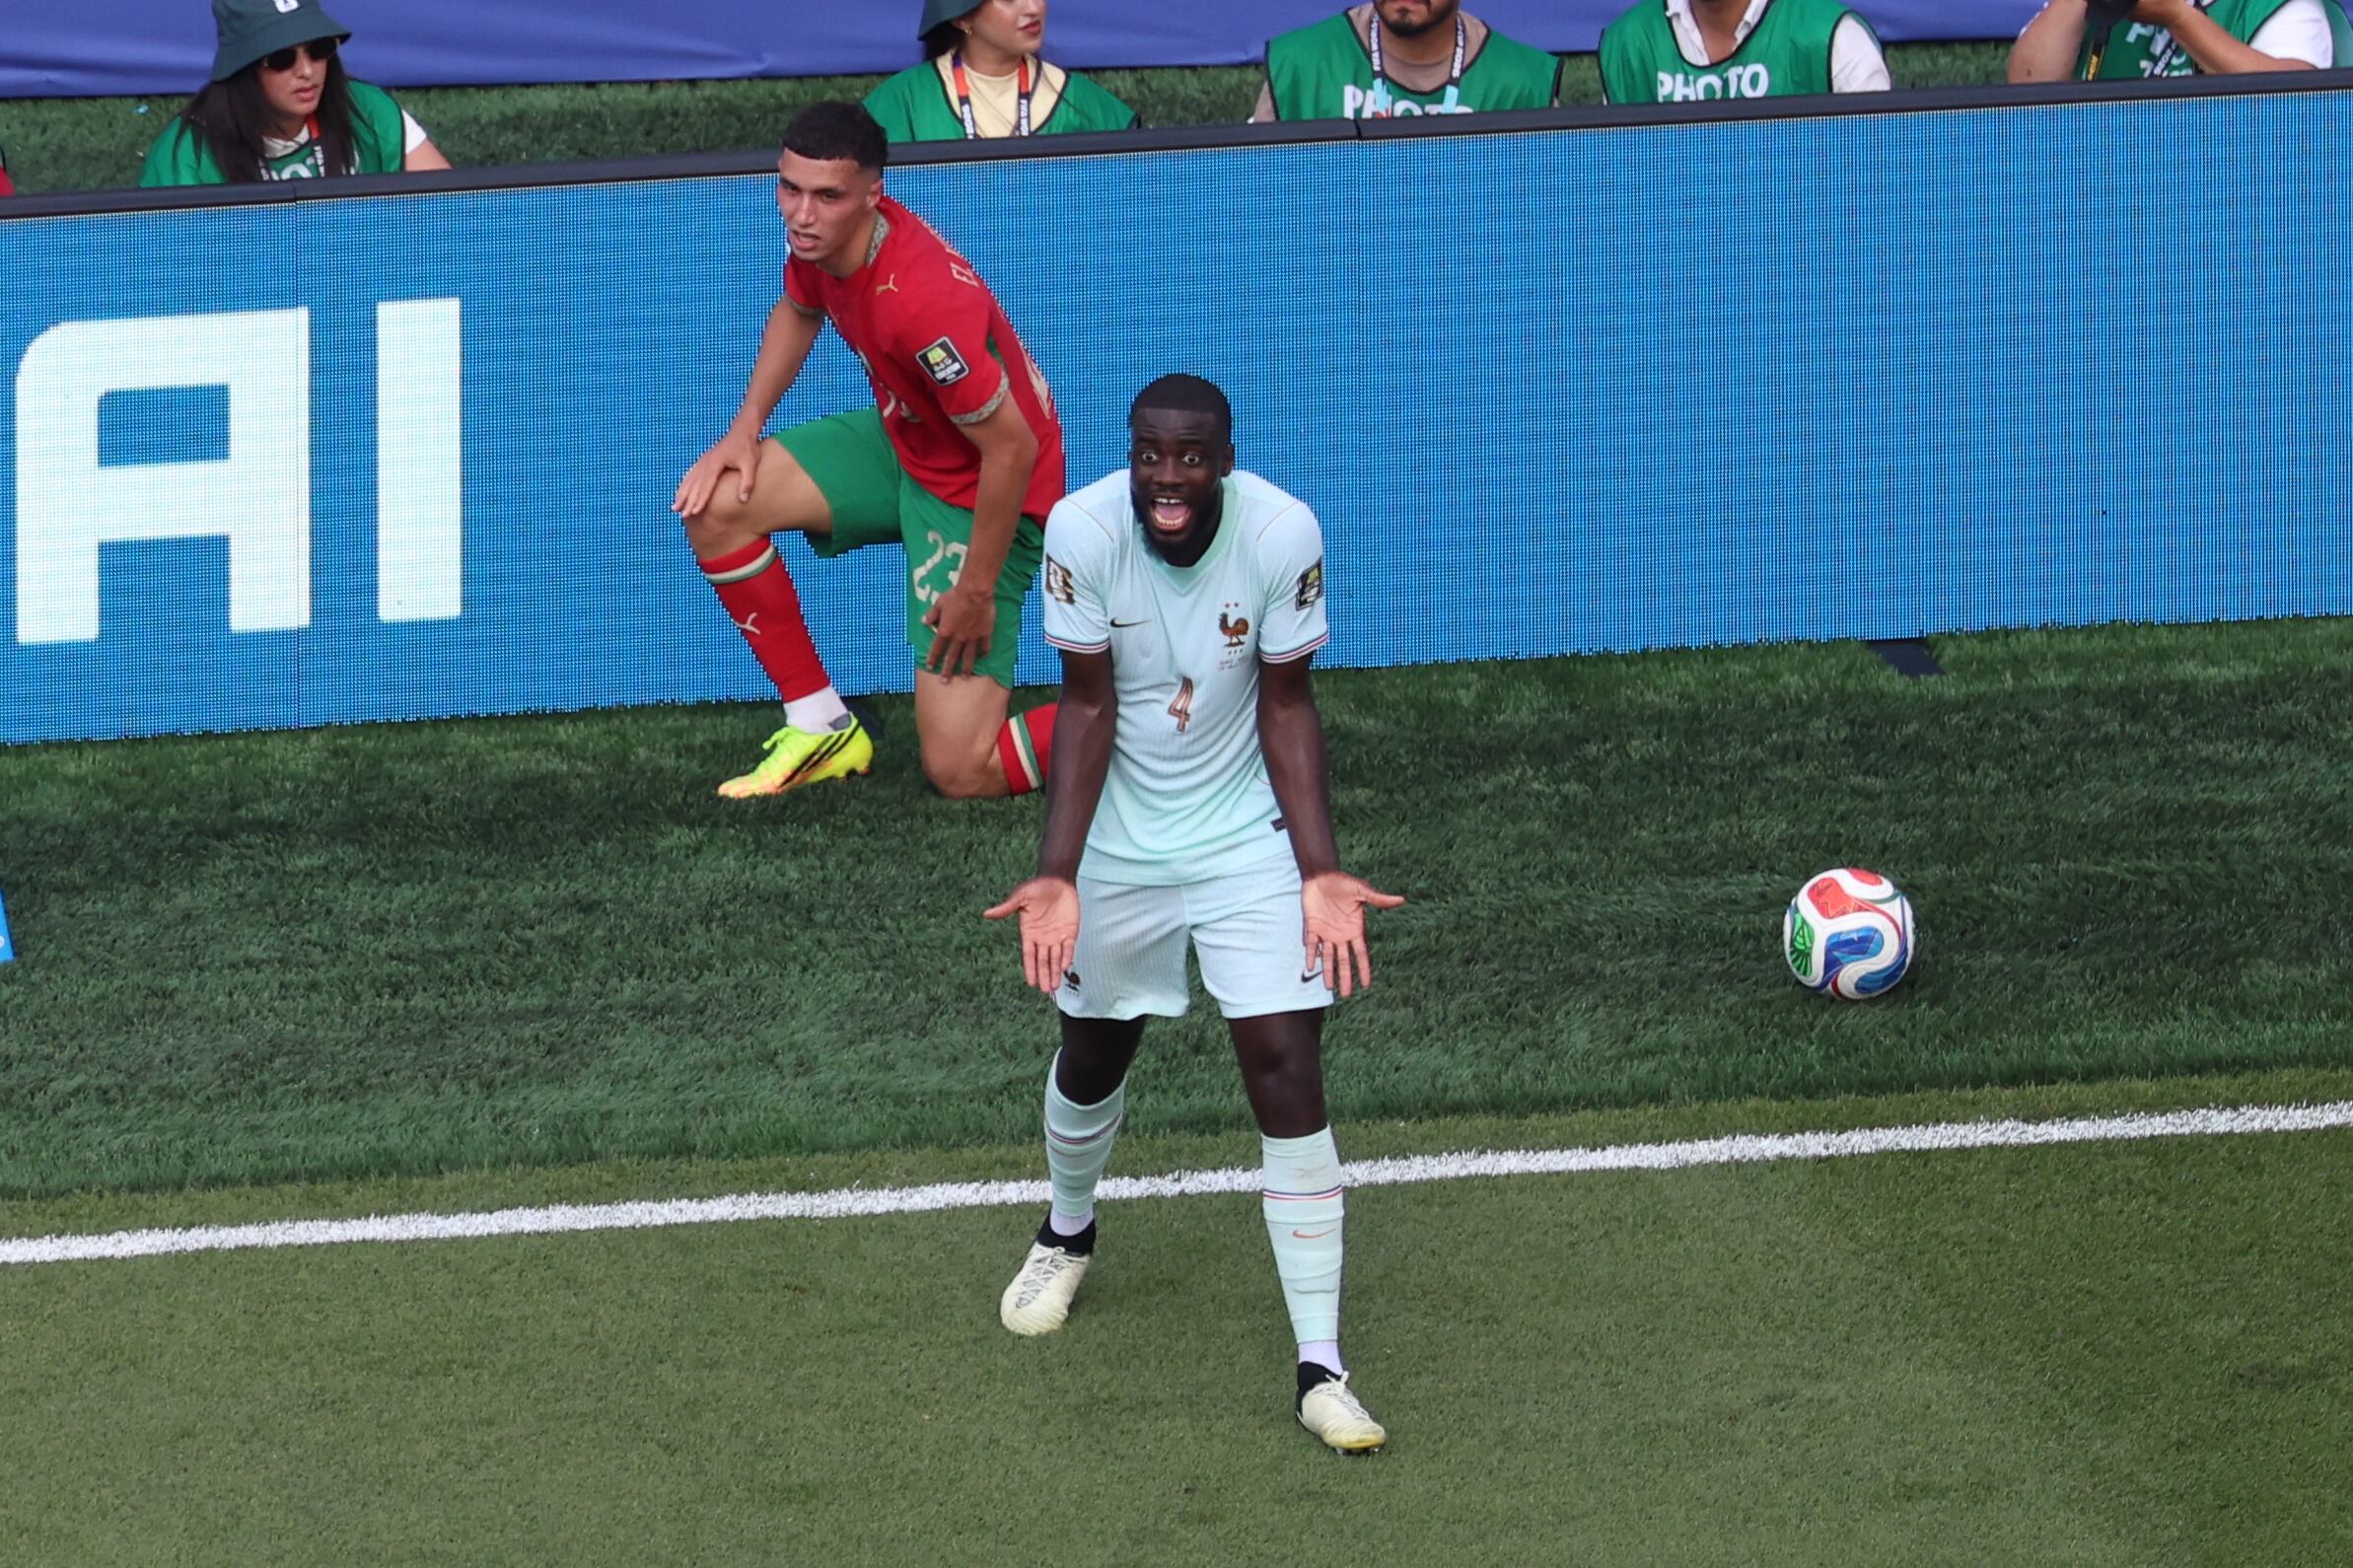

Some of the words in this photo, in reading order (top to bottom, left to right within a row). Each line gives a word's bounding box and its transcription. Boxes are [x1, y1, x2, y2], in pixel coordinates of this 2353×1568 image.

[1657, 62, 1769, 103] PHOTO
[16, 297, 463, 645] AI
[912, 531, 969, 606] 23
[1167, 677, 1194, 733] 4
